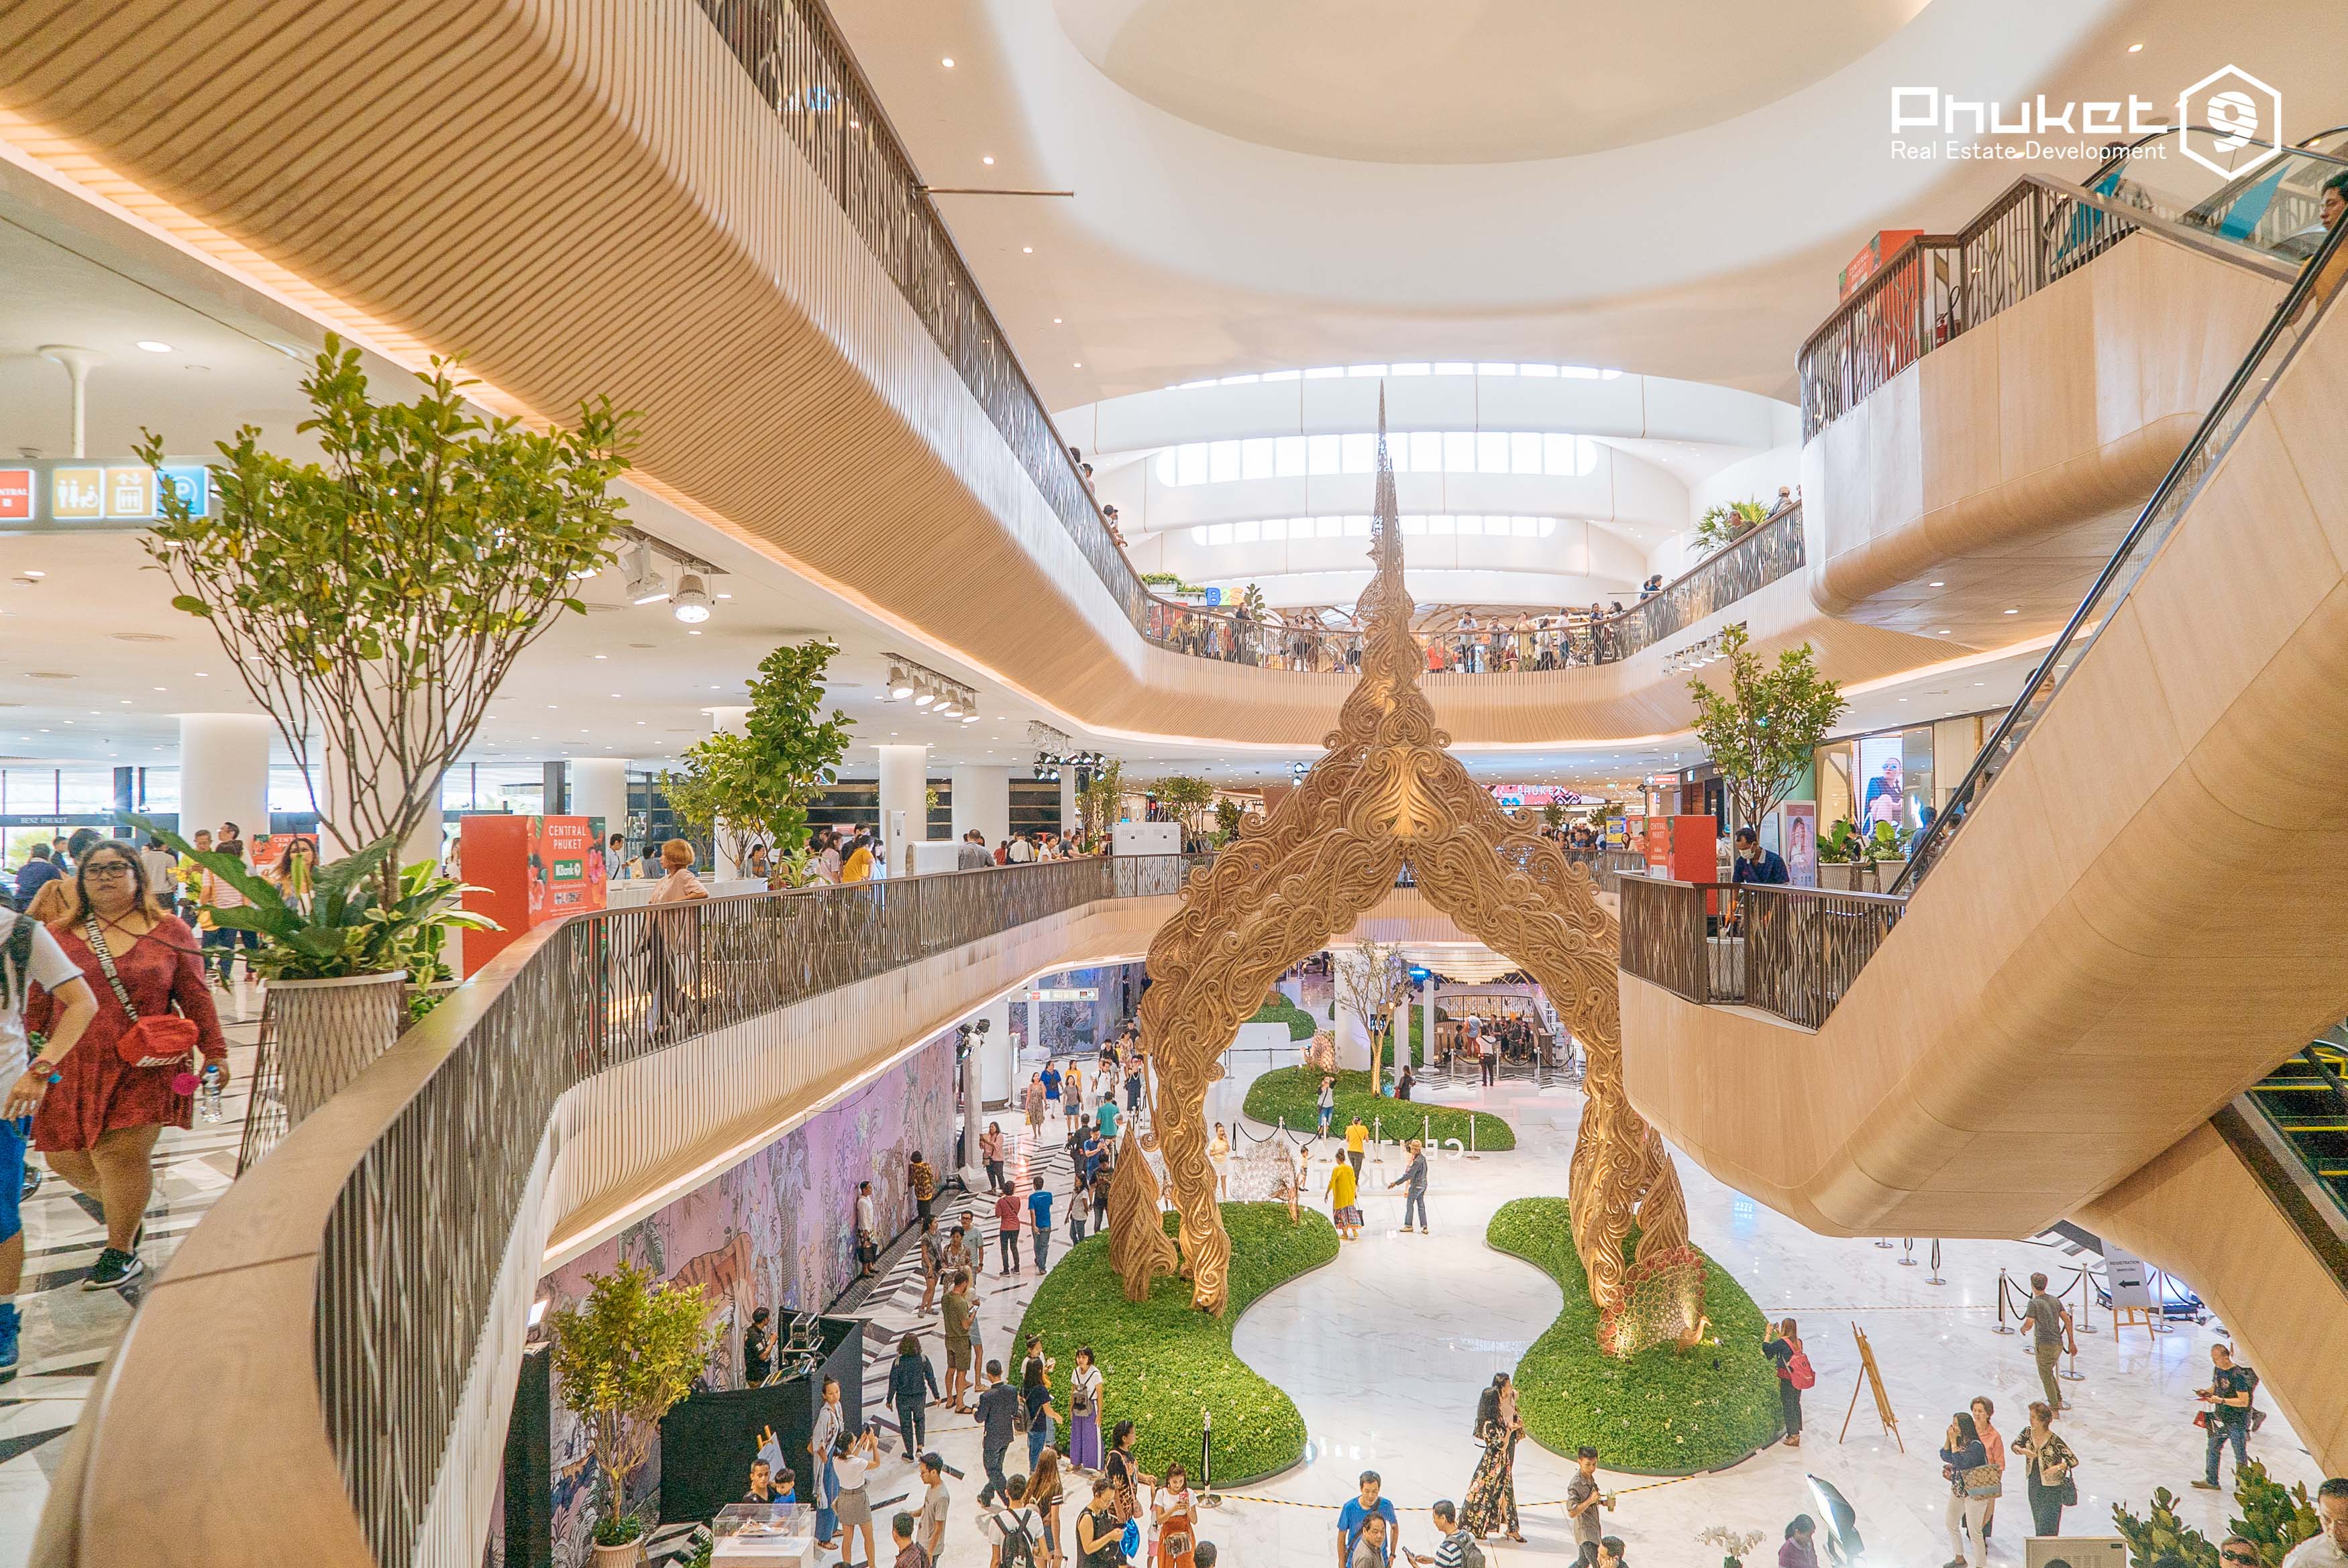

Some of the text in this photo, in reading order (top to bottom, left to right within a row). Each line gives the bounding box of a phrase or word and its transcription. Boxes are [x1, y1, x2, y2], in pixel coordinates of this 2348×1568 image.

[1206, 587, 1244, 606] B2S
[548, 826, 586, 836] CENTRAL
[553, 839, 582, 849] PHUKET
